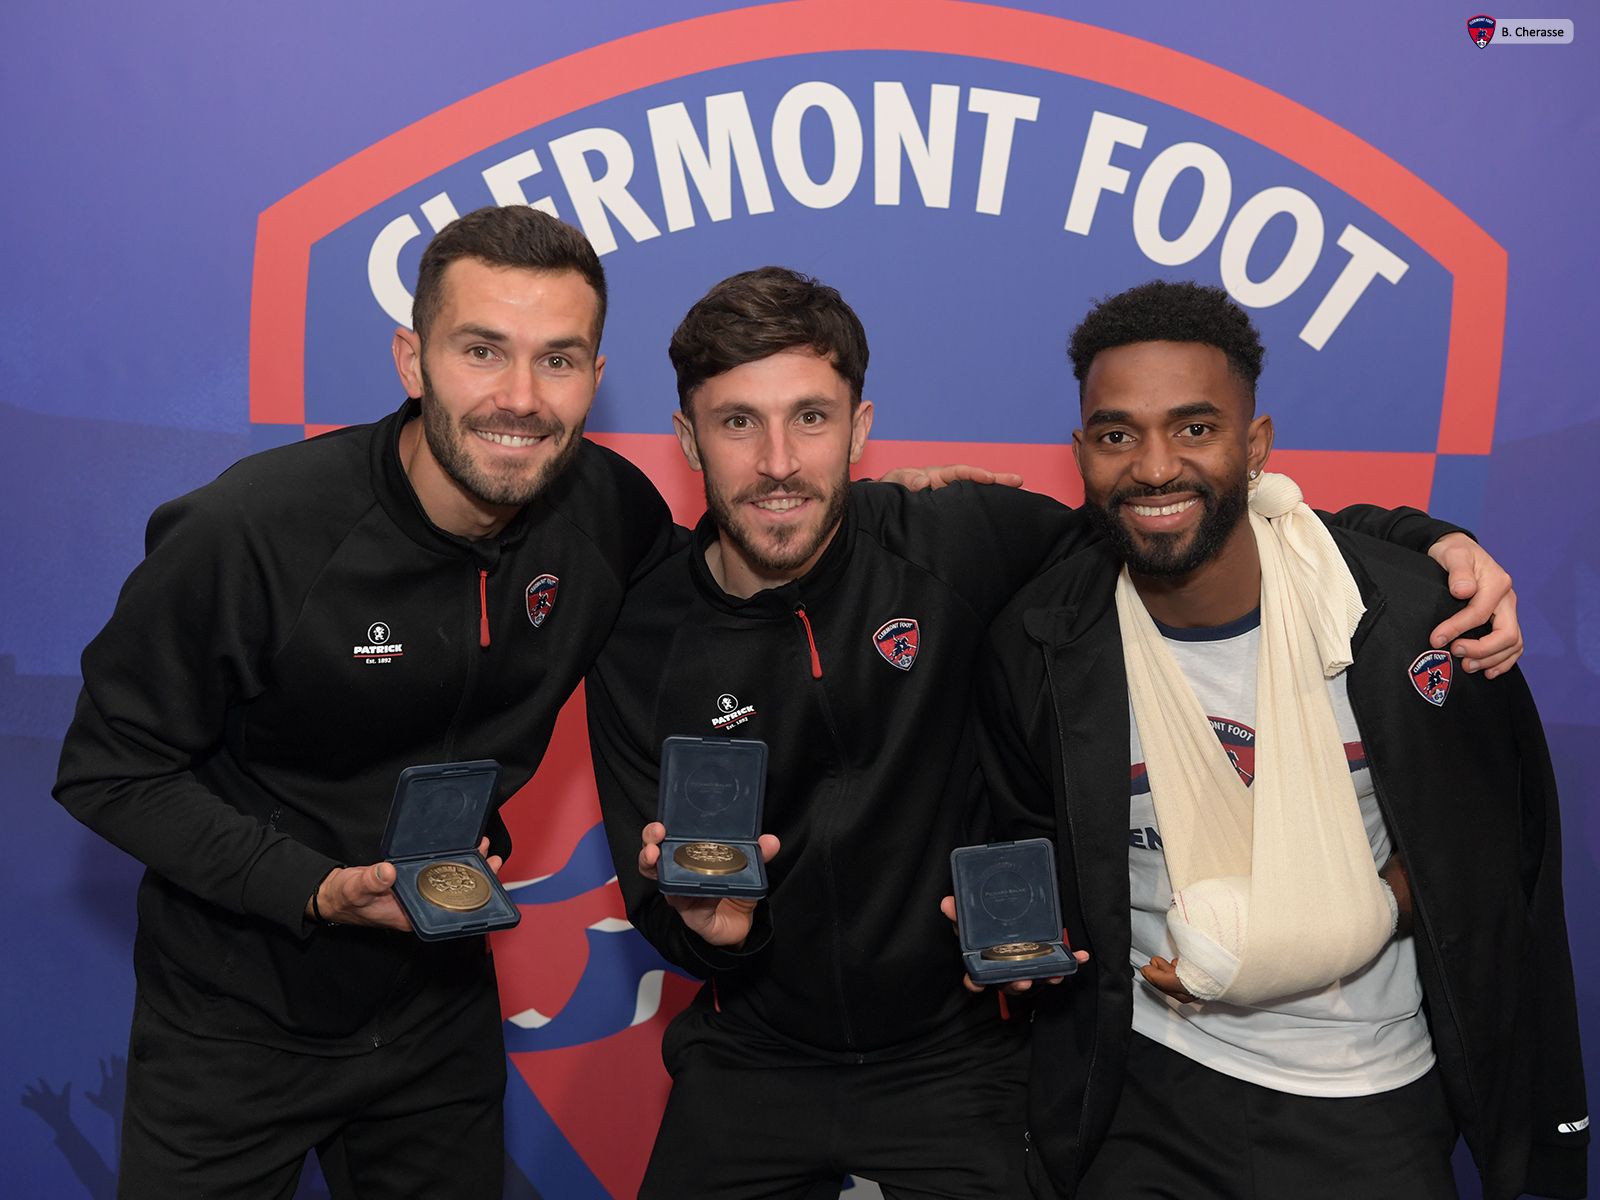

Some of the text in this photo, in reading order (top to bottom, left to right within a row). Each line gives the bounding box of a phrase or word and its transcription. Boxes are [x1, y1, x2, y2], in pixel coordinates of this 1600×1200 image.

[1064, 110, 1410, 351] FOOT
[353, 643, 403, 654] PATRICK
[711, 704, 755, 726] PATRICK
[1227, 724, 1254, 741] FOOT
